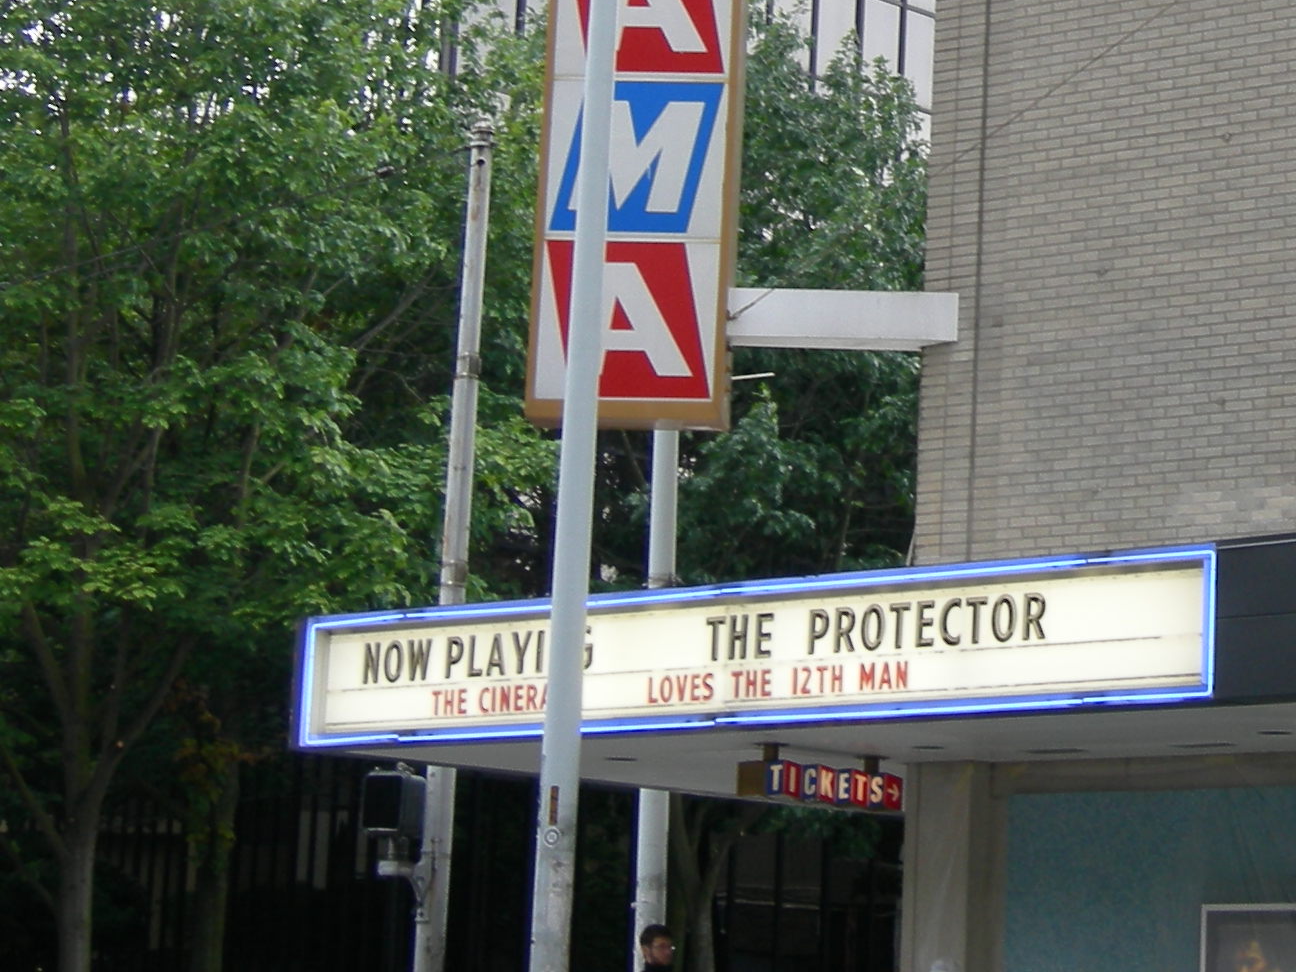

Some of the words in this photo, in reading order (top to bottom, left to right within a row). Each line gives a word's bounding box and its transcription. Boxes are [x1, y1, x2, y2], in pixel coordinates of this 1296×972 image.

[362, 637, 433, 685] NOW
[444, 625, 594, 679] PLAYIG
[706, 612, 774, 662] THE
[807, 592, 1047, 655] PROTECTOR
[431, 687, 467, 717] THE
[647, 672, 714, 705] LOVES
[731, 668, 772, 699] THE
[790, 664, 844, 696] 12TH
[859, 659, 909, 692] MAN
[769, 763, 884, 804] TICKETS
